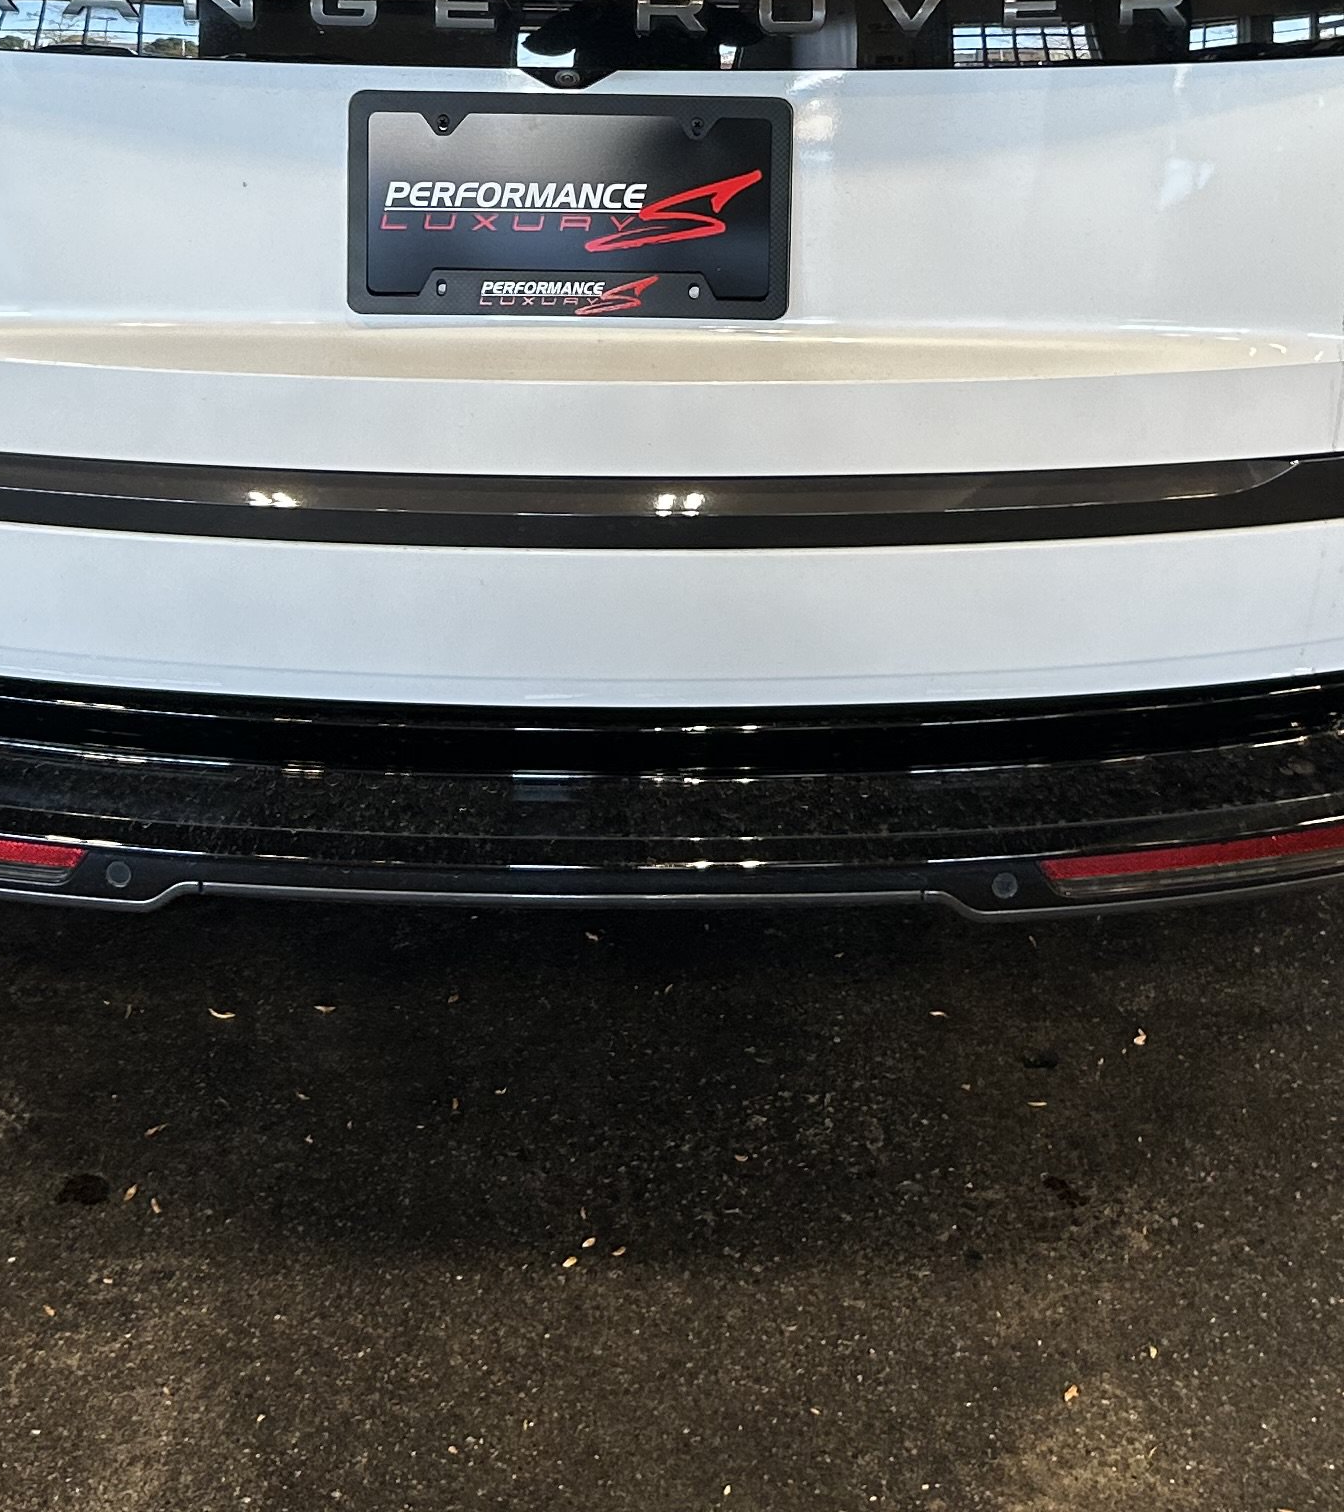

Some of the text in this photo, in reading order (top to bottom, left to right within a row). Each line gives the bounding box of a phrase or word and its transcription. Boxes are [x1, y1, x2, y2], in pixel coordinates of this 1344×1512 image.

[384, 181, 648, 210] PERFORMANCE
[379, 212, 640, 232] LUXURY
[481, 281, 606, 296] PERFORMANCE
[479, 296, 601, 306] LUXURY
